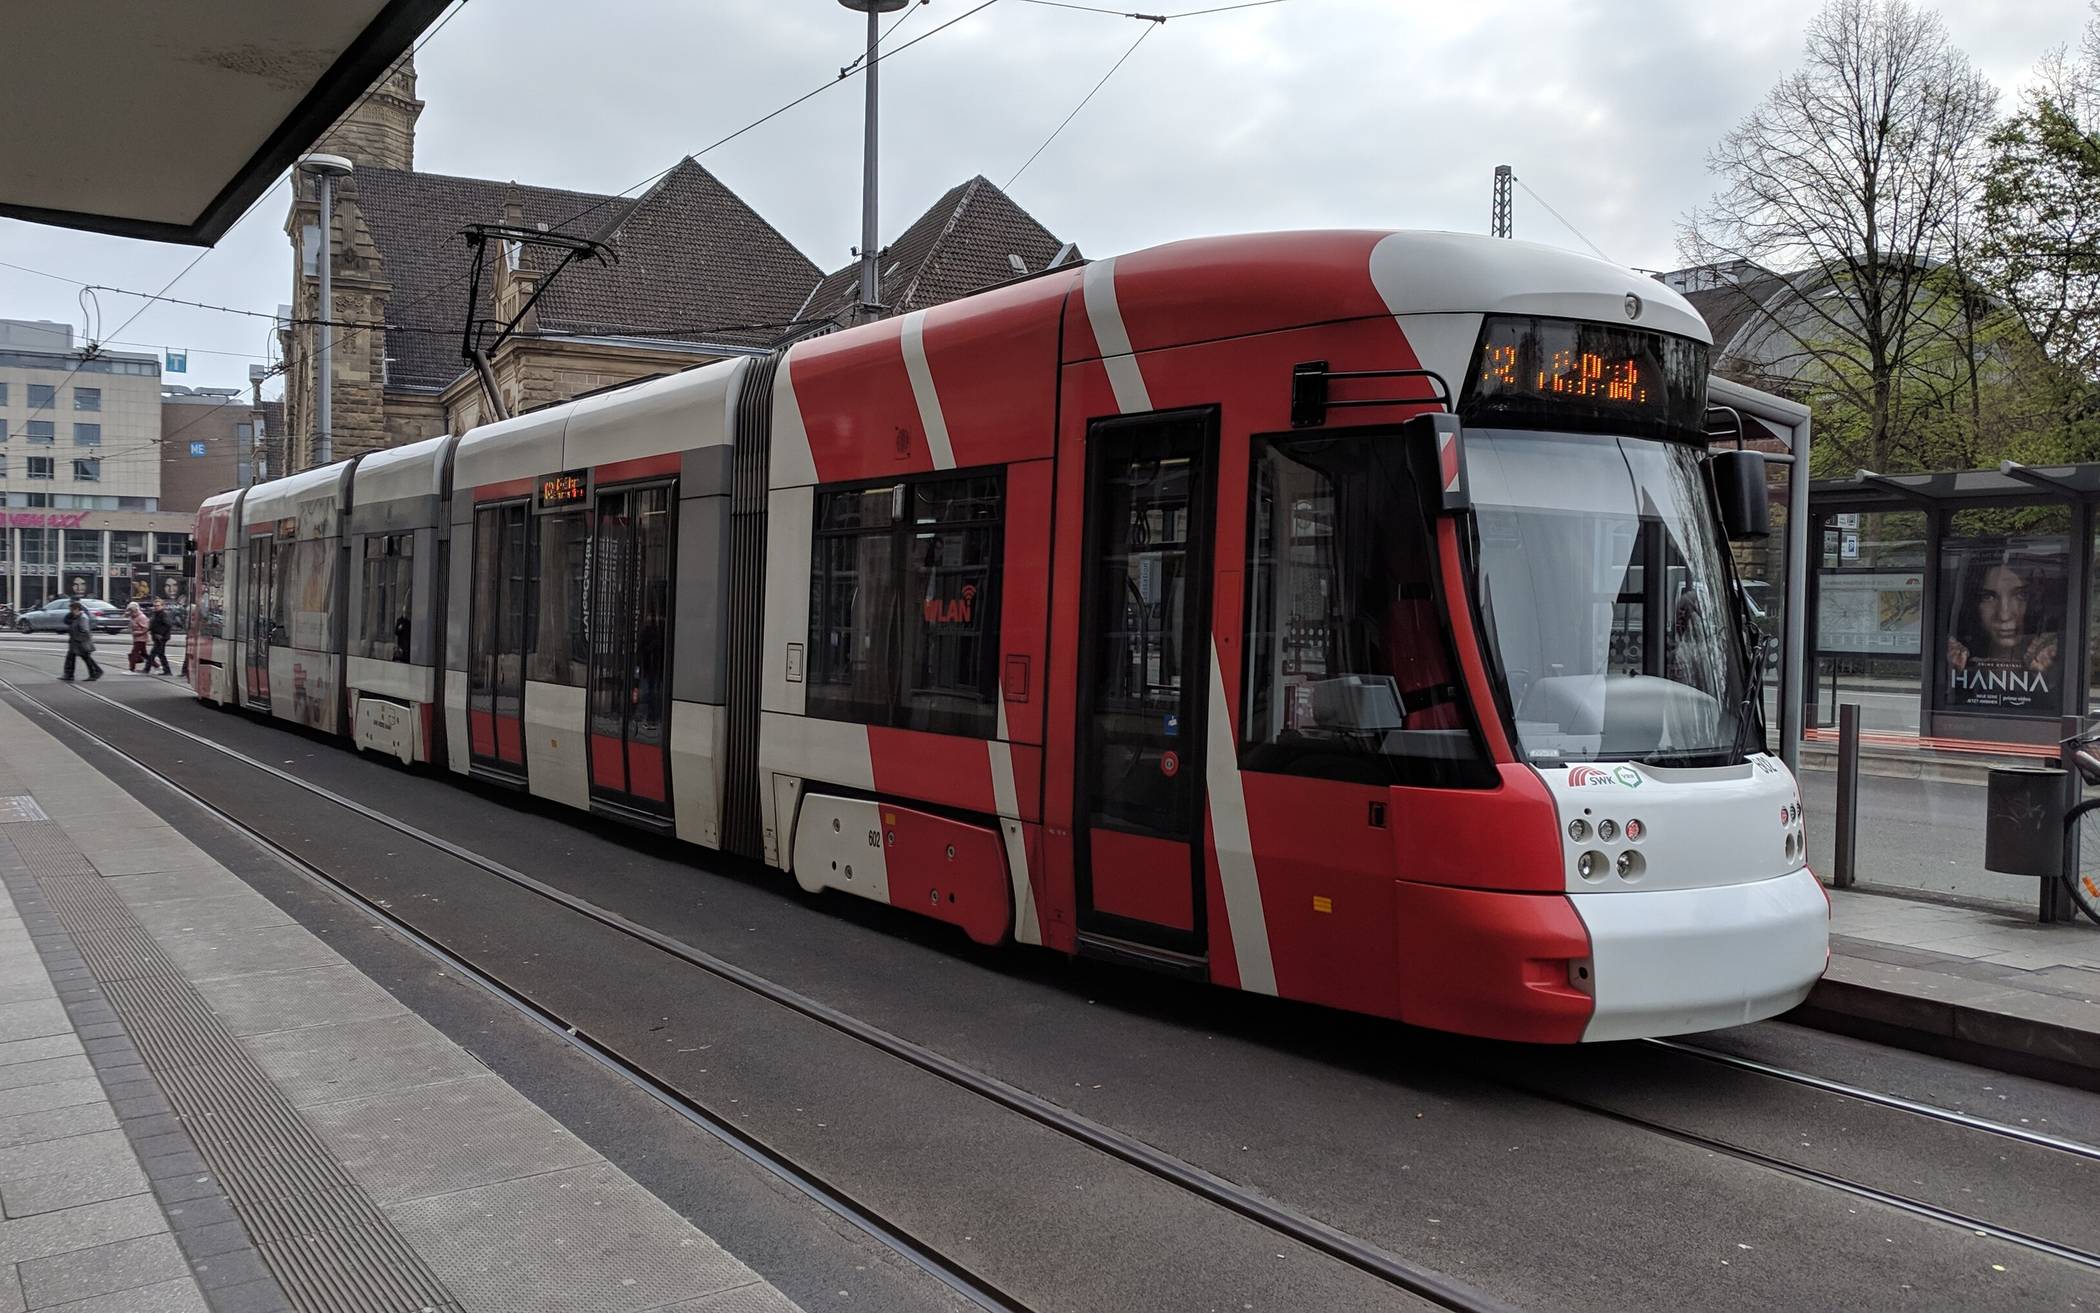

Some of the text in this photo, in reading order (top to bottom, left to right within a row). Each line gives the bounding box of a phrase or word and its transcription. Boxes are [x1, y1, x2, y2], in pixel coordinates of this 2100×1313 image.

[190, 443, 206, 455] ME
[924, 599, 971, 622] WLAN
[1951, 669, 2049, 692] HANNA
[1589, 776, 1616, 786] SWK
[868, 830, 881, 847] 602
